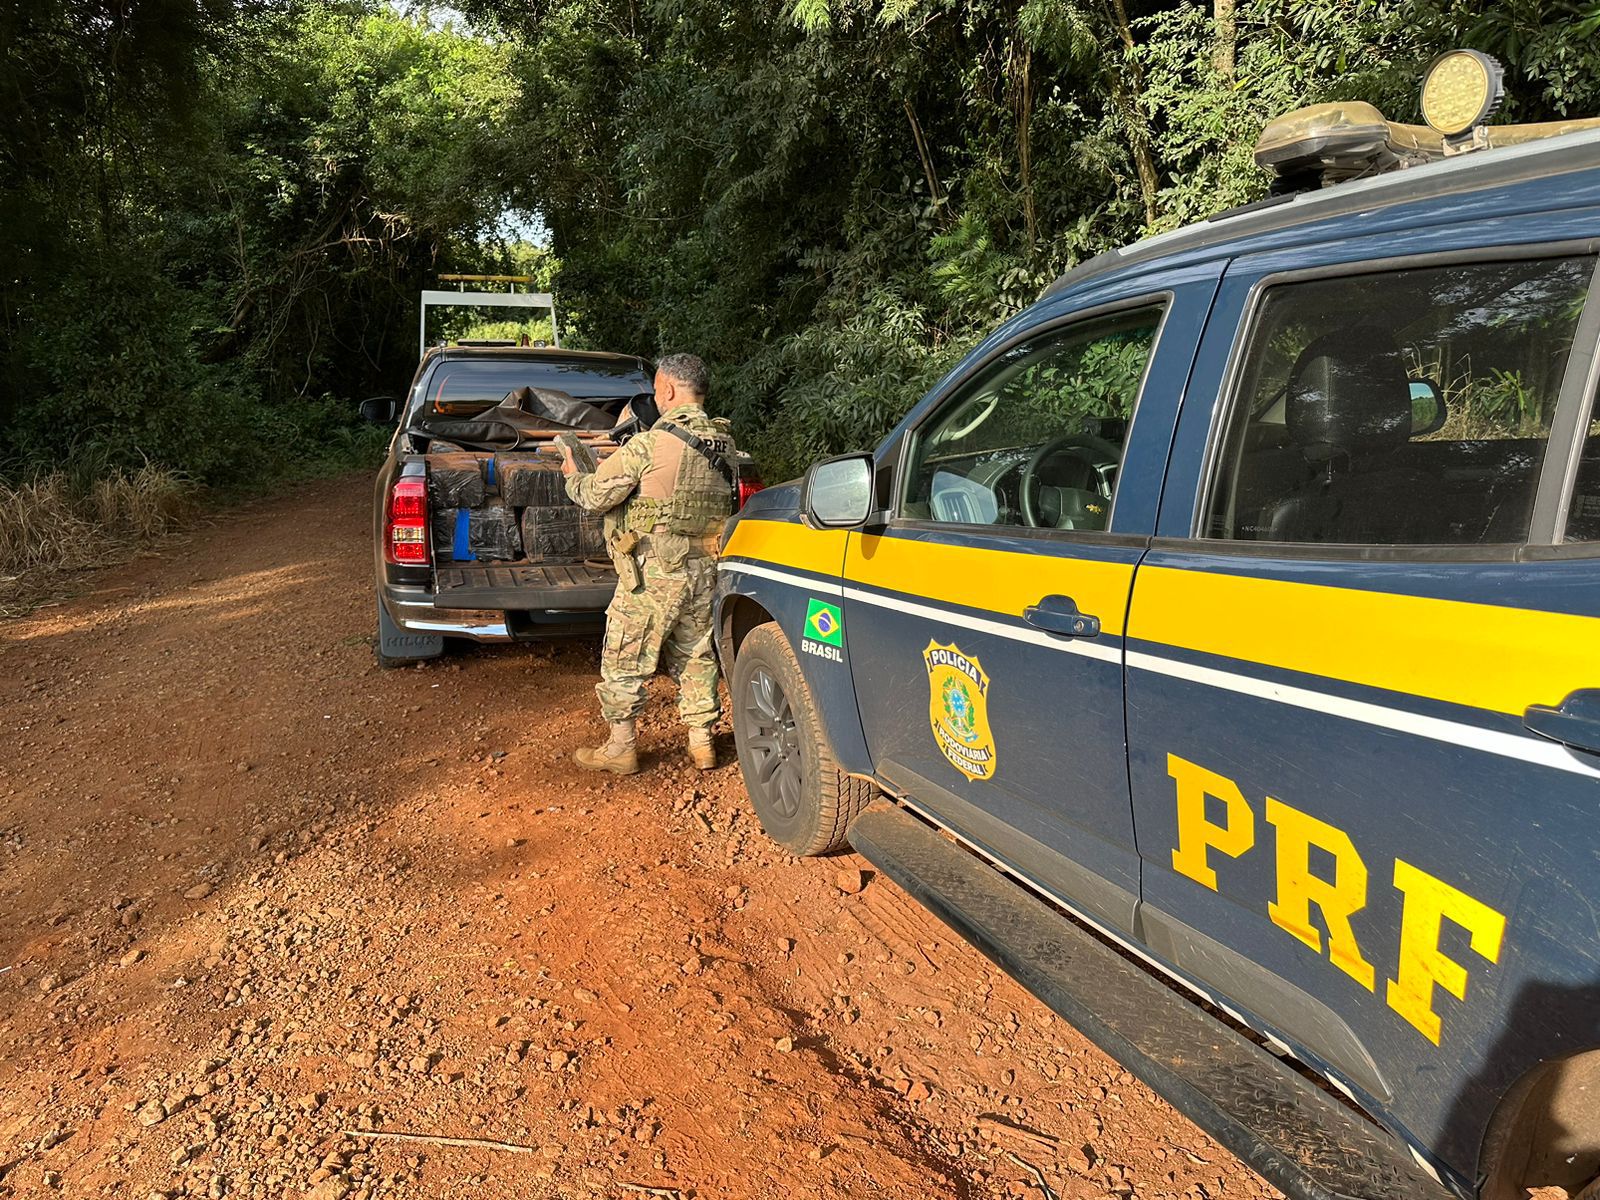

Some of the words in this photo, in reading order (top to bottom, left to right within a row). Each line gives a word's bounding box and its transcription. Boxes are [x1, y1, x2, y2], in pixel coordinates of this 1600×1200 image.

[703, 438, 728, 453] PRF
[801, 639, 843, 663] BRASIL
[931, 650, 977, 682] POLICIA
[939, 727, 988, 761] RODOVIARIA
[948, 748, 984, 775] FEDERAL
[1167, 752, 1506, 1047] PRF
